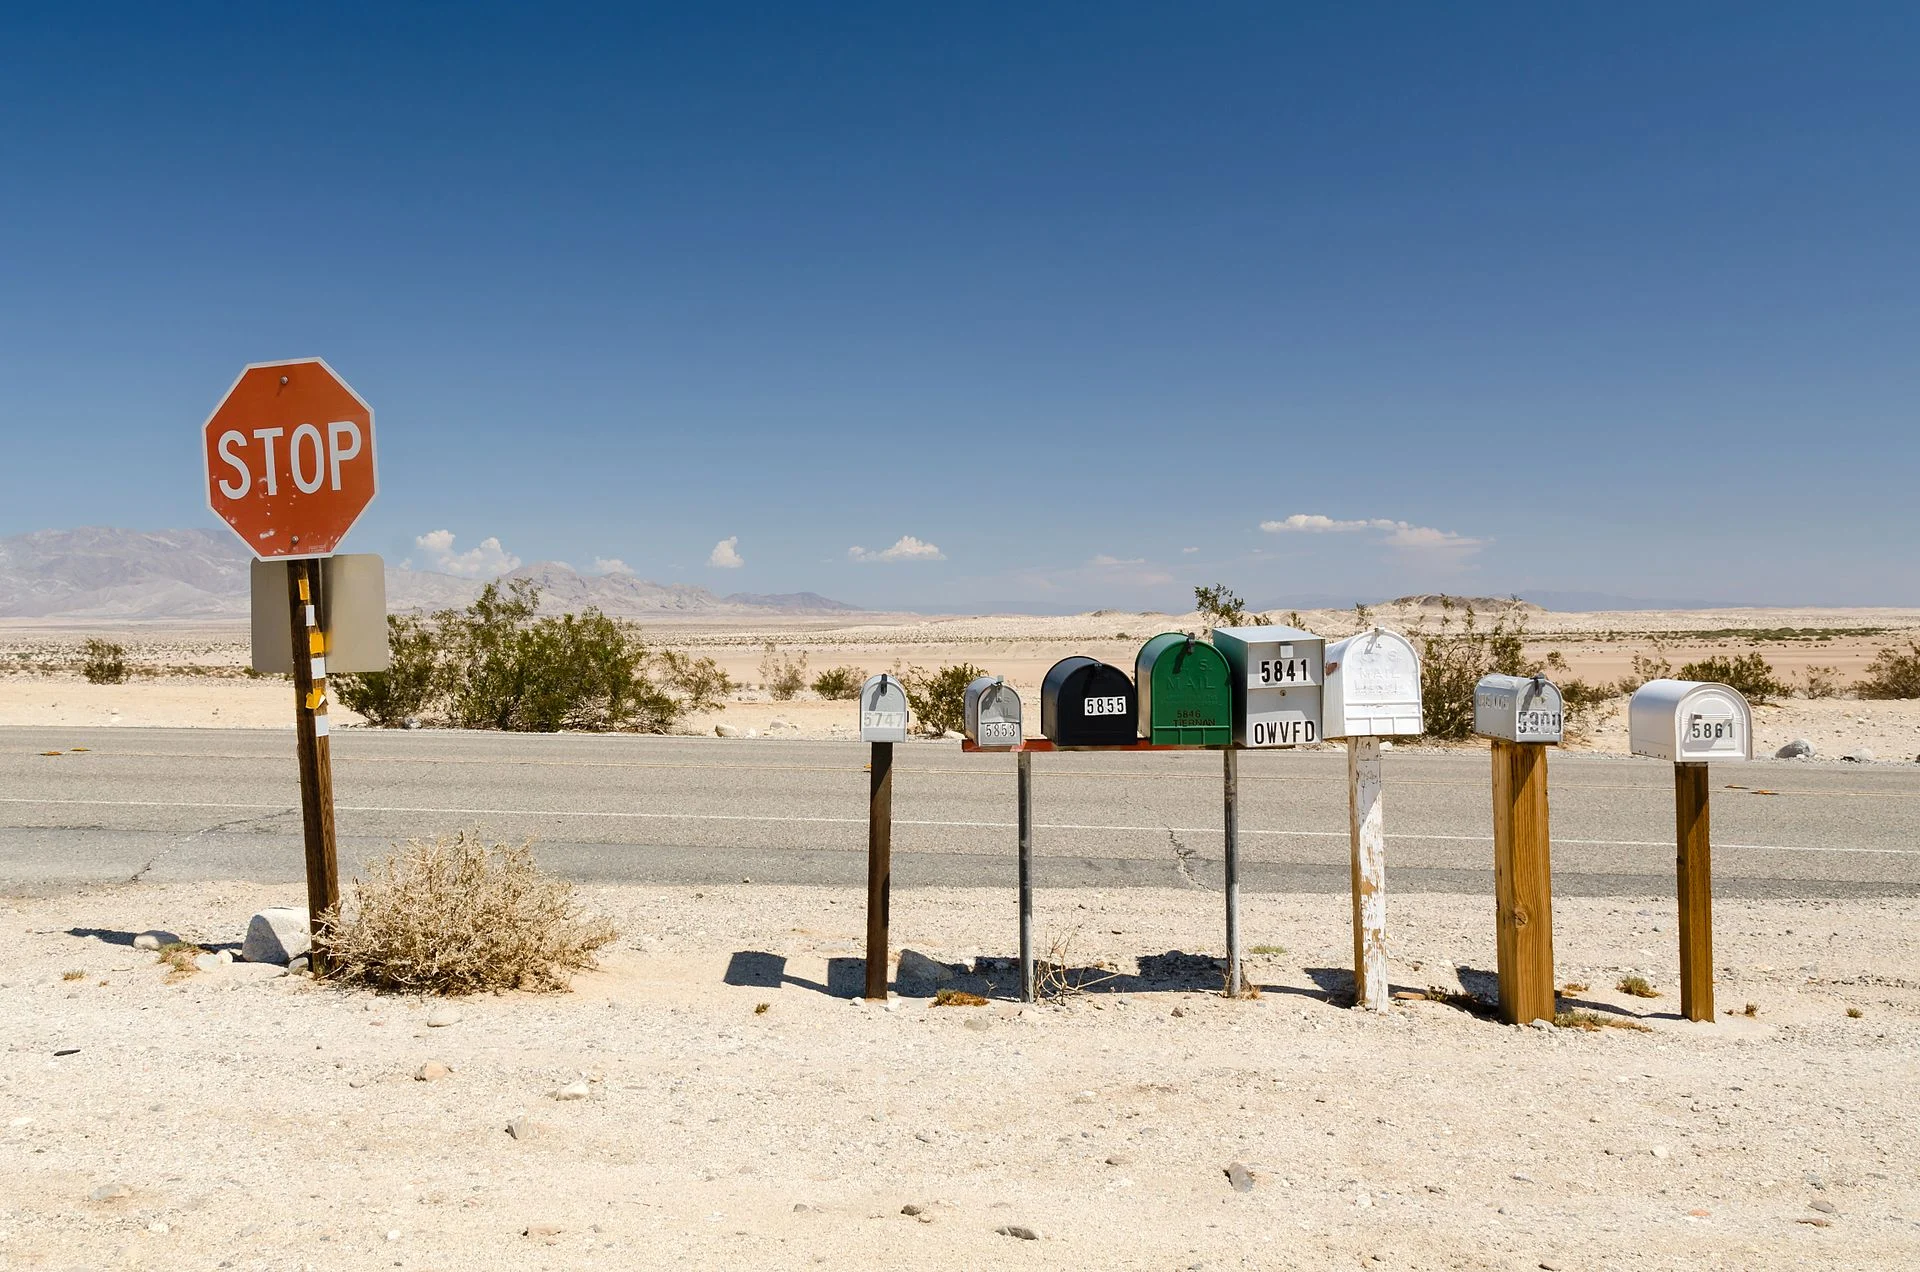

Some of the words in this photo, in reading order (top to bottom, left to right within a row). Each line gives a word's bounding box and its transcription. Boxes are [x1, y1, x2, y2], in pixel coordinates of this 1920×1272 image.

[218, 421, 362, 500] STOP
[1260, 658, 1308, 683] 5841
[1166, 675, 1216, 690] MAIL
[1087, 697, 1124, 714] 5855
[1176, 709, 1201, 719] 5846
[863, 712, 904, 727] 5747
[986, 723, 1016, 737] 5853
[1254, 720, 1316, 745] OWVFD
[1691, 722, 1733, 739] 5861
